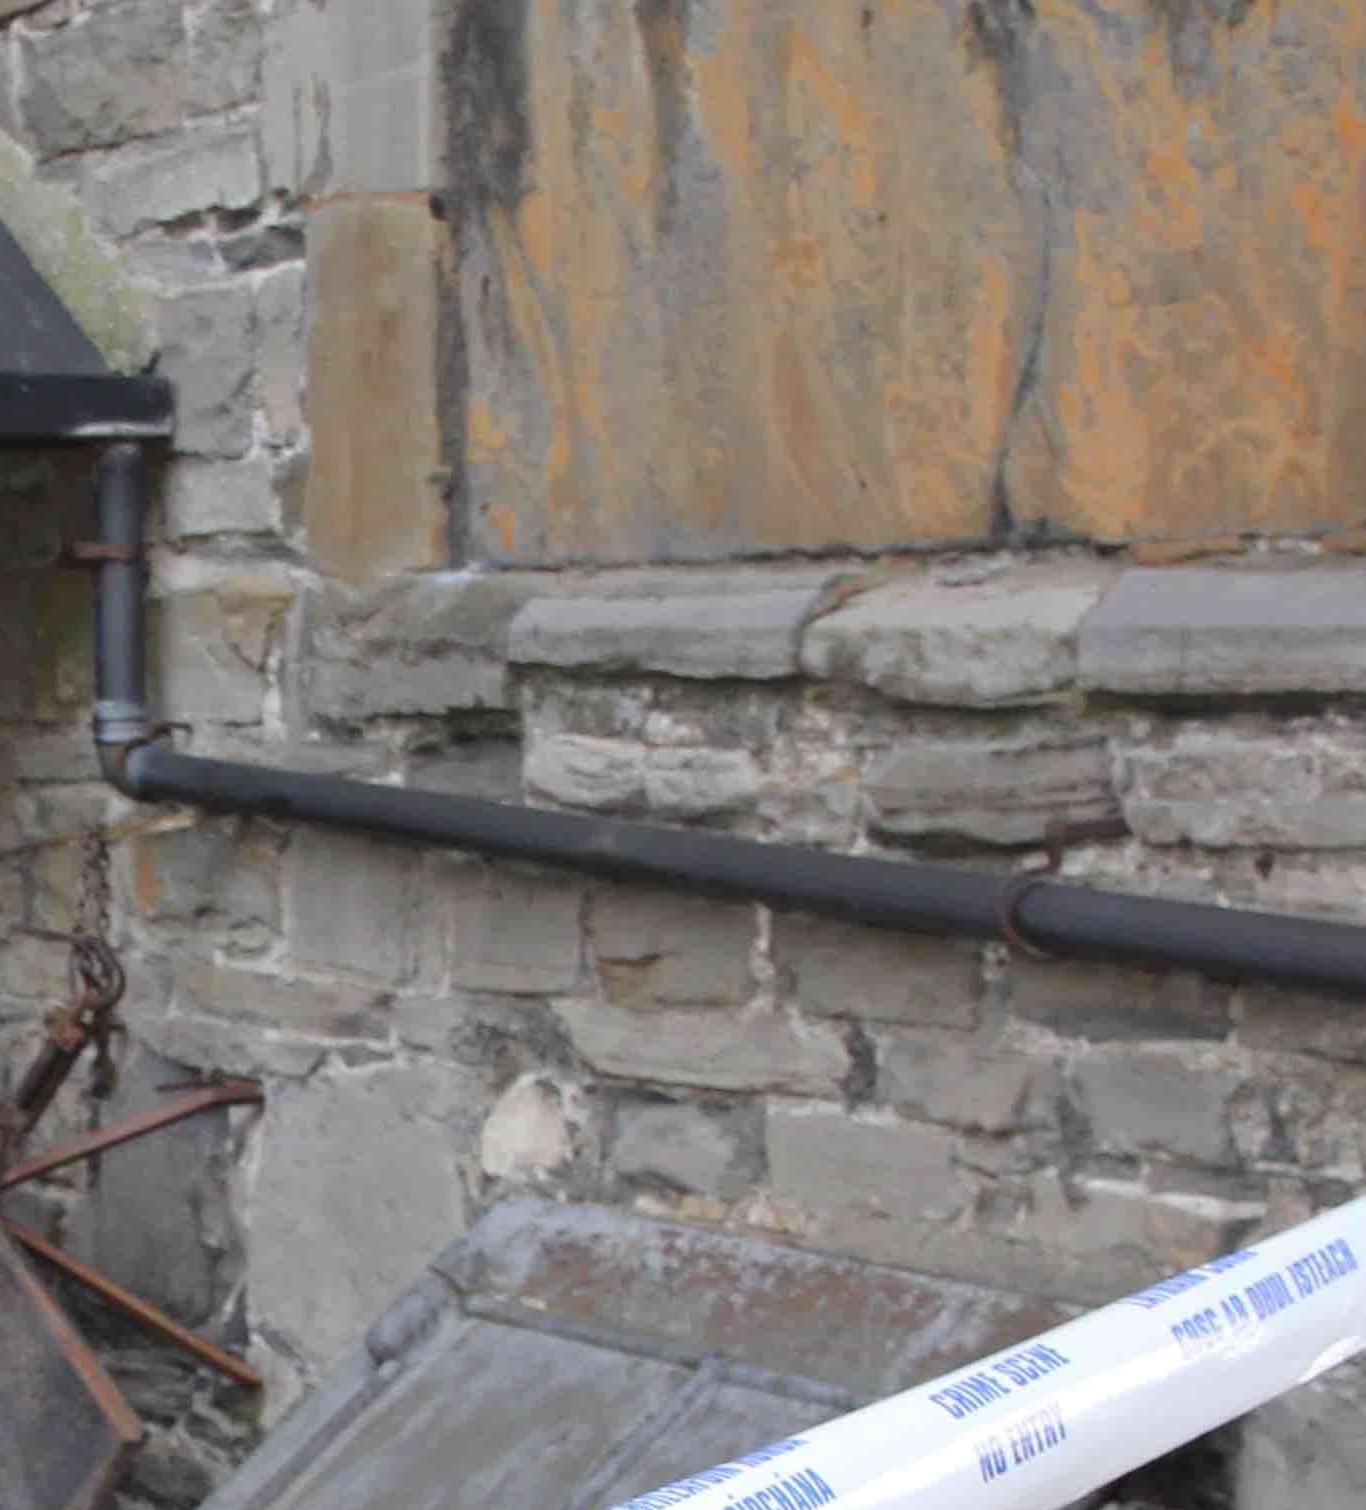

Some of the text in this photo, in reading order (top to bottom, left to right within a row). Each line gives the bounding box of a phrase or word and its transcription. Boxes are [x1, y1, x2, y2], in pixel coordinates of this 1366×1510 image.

[929, 1344, 1070, 1419] CRIME SCENE
[973, 1400, 1066, 1484] NO ENTRY
